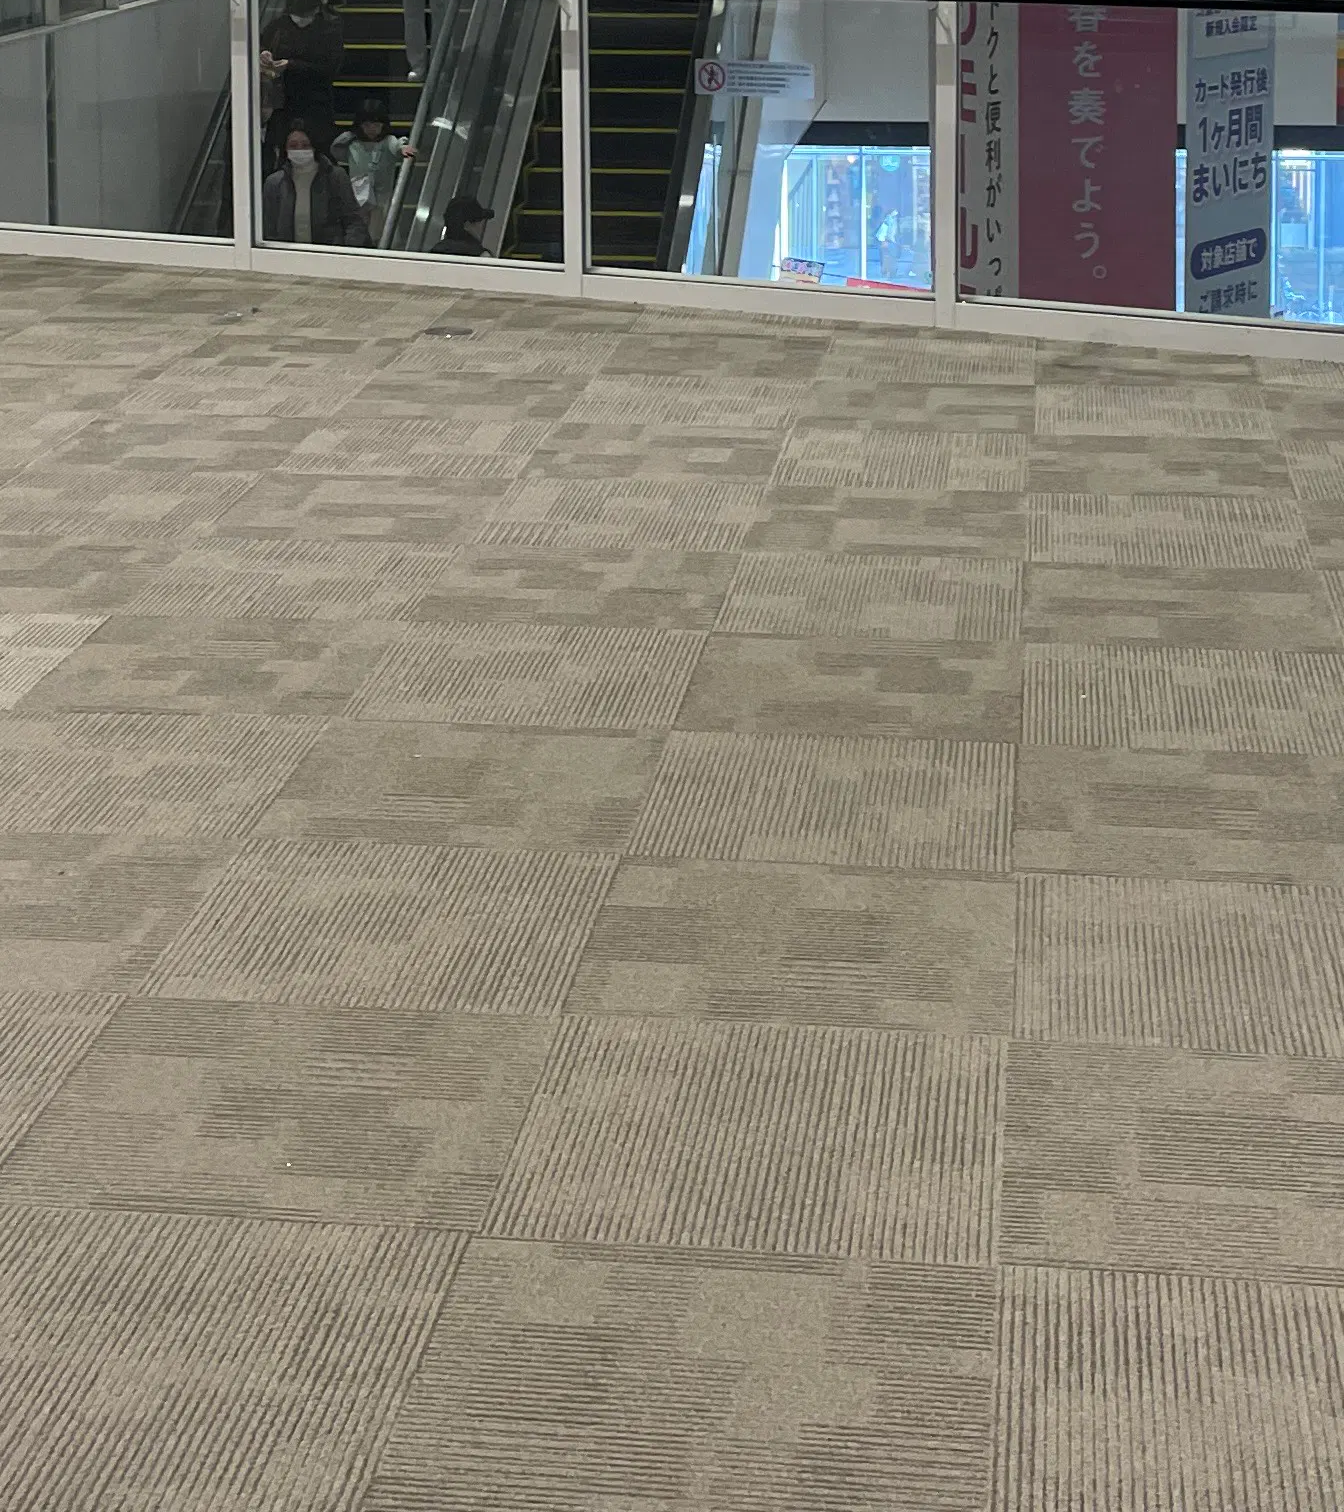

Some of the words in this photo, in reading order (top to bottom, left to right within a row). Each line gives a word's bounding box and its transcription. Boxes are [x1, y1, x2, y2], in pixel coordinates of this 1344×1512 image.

[1194, 67, 1268, 103] カード発行後
[1192, 152, 1267, 203] まいにち
[1200, 238, 1257, 272] 対象店舗で
